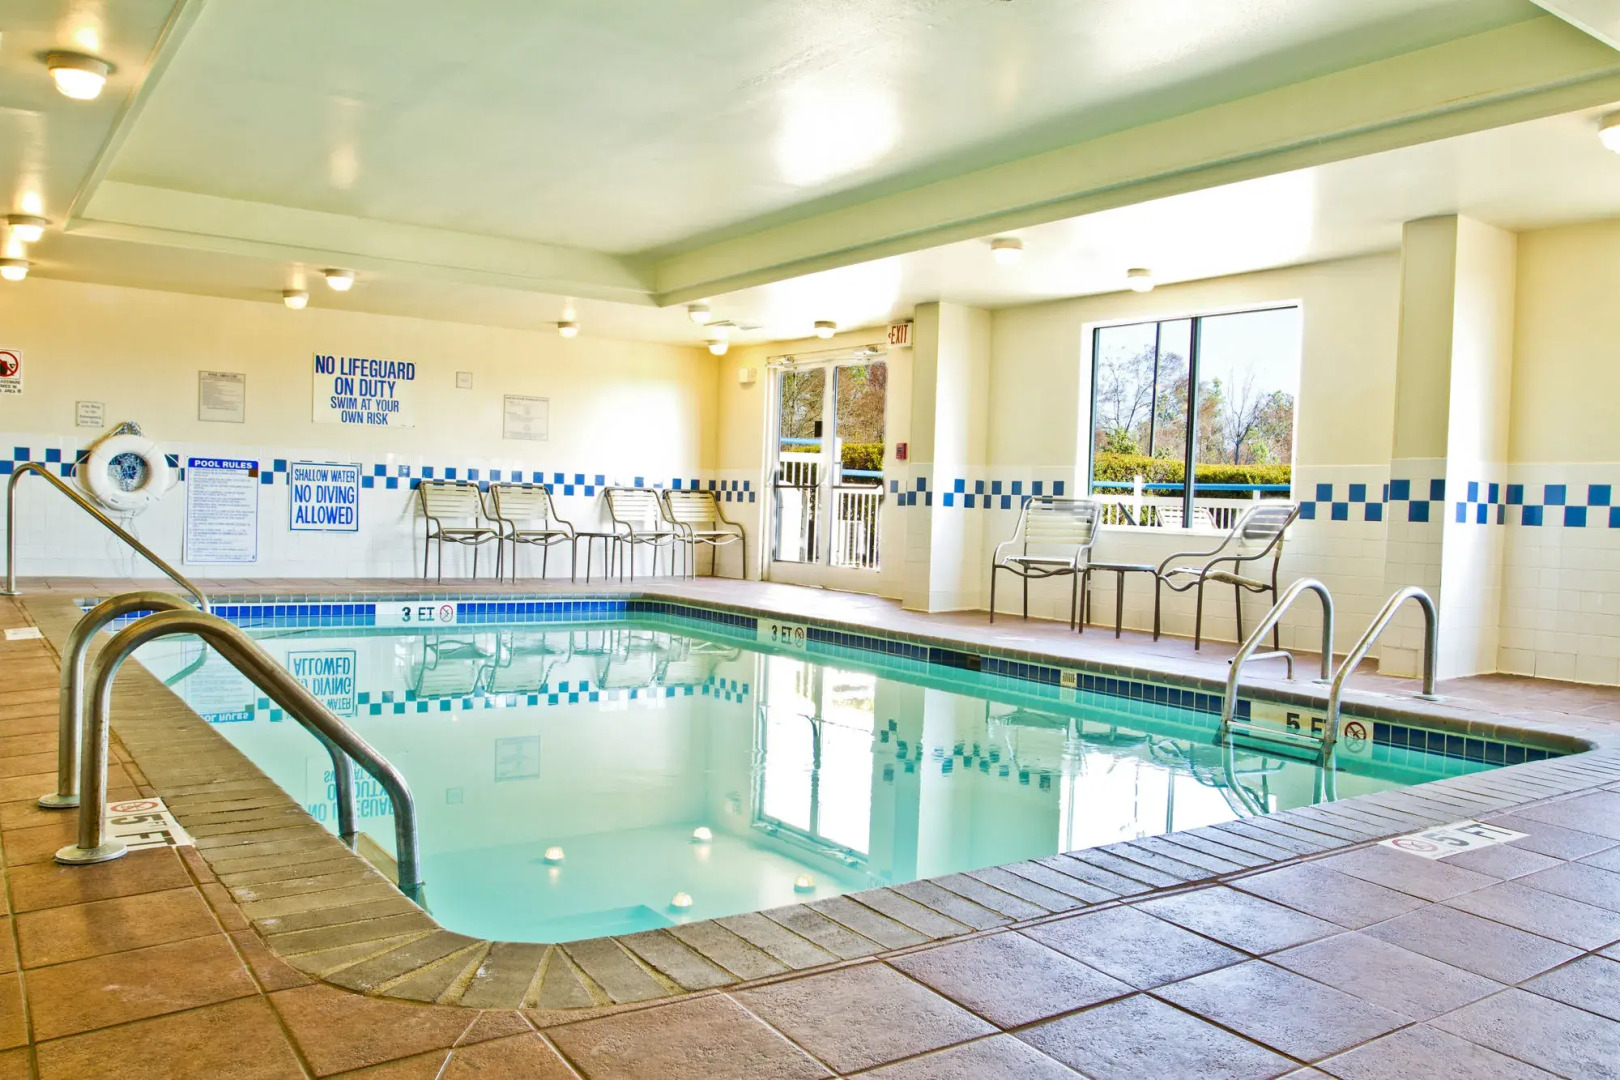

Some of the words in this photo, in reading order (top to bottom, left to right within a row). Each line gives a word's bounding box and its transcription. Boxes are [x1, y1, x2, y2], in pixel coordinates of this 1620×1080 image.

[891, 324, 908, 344] EXIT
[315, 355, 335, 374] NO
[340, 357, 415, 380] LIFEGUARD
[334, 376, 354, 396] ON
[359, 378, 396, 398] DUTY
[330, 396, 357, 410] SWIM
[360, 398, 372, 410] AT
[376, 400, 399, 413] YOUR
[341, 410, 363, 423] OWN
[367, 412, 388, 425] RISK
[194, 460, 220, 468] POOL
[222, 461, 252, 469] RULES
[294, 468, 328, 482] SHALLOW
[330, 470, 355, 483] WATER
[294, 484, 312, 503] NO
[316, 485, 355, 504] DIVING
[295, 505, 353, 525] ALLOWED
